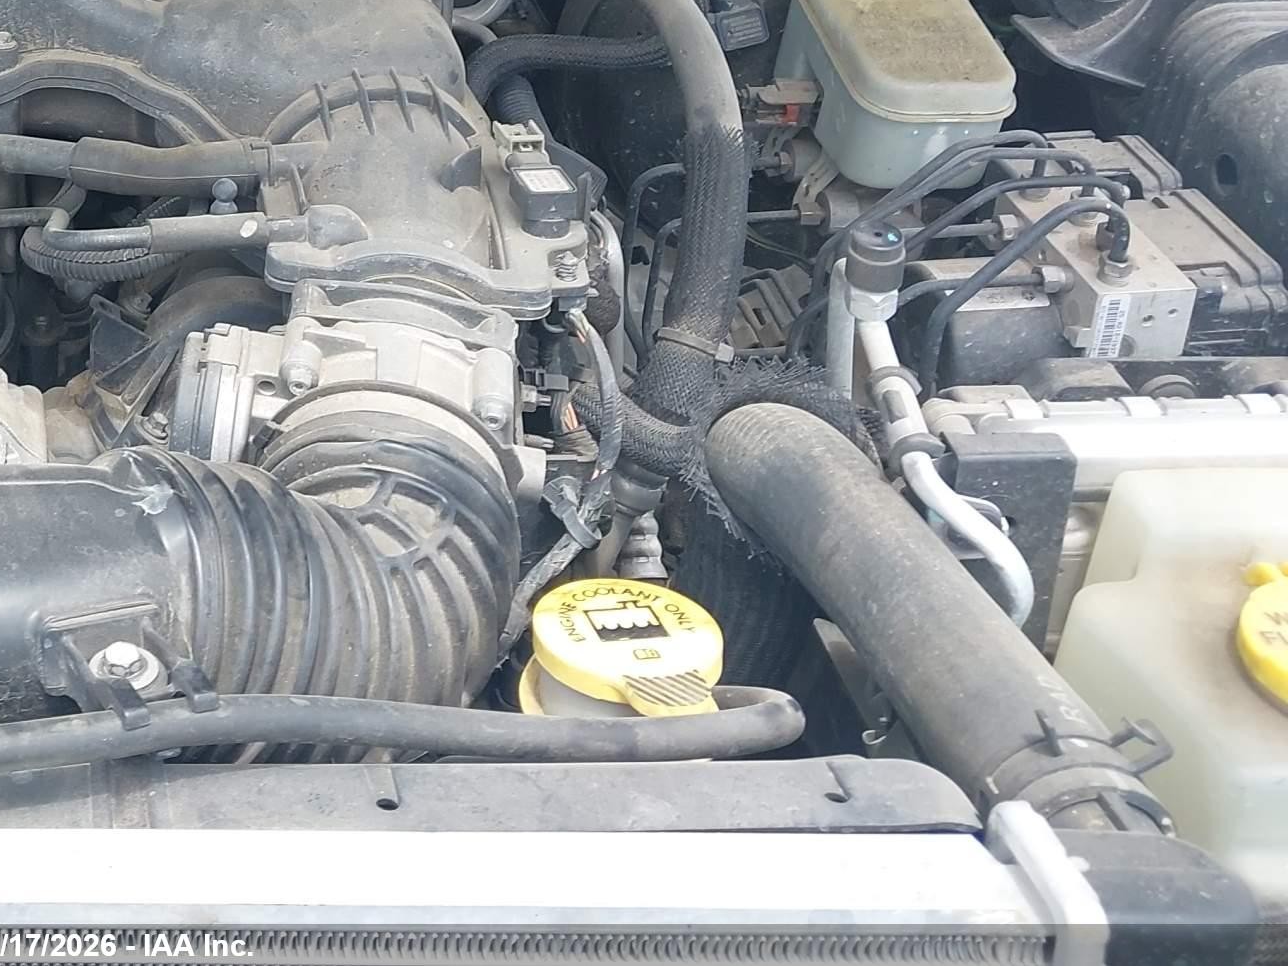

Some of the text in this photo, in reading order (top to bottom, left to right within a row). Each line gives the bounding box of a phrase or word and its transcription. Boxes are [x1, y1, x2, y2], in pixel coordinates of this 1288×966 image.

[558, 587, 696, 642] ENGINE COOLANT ONLY
